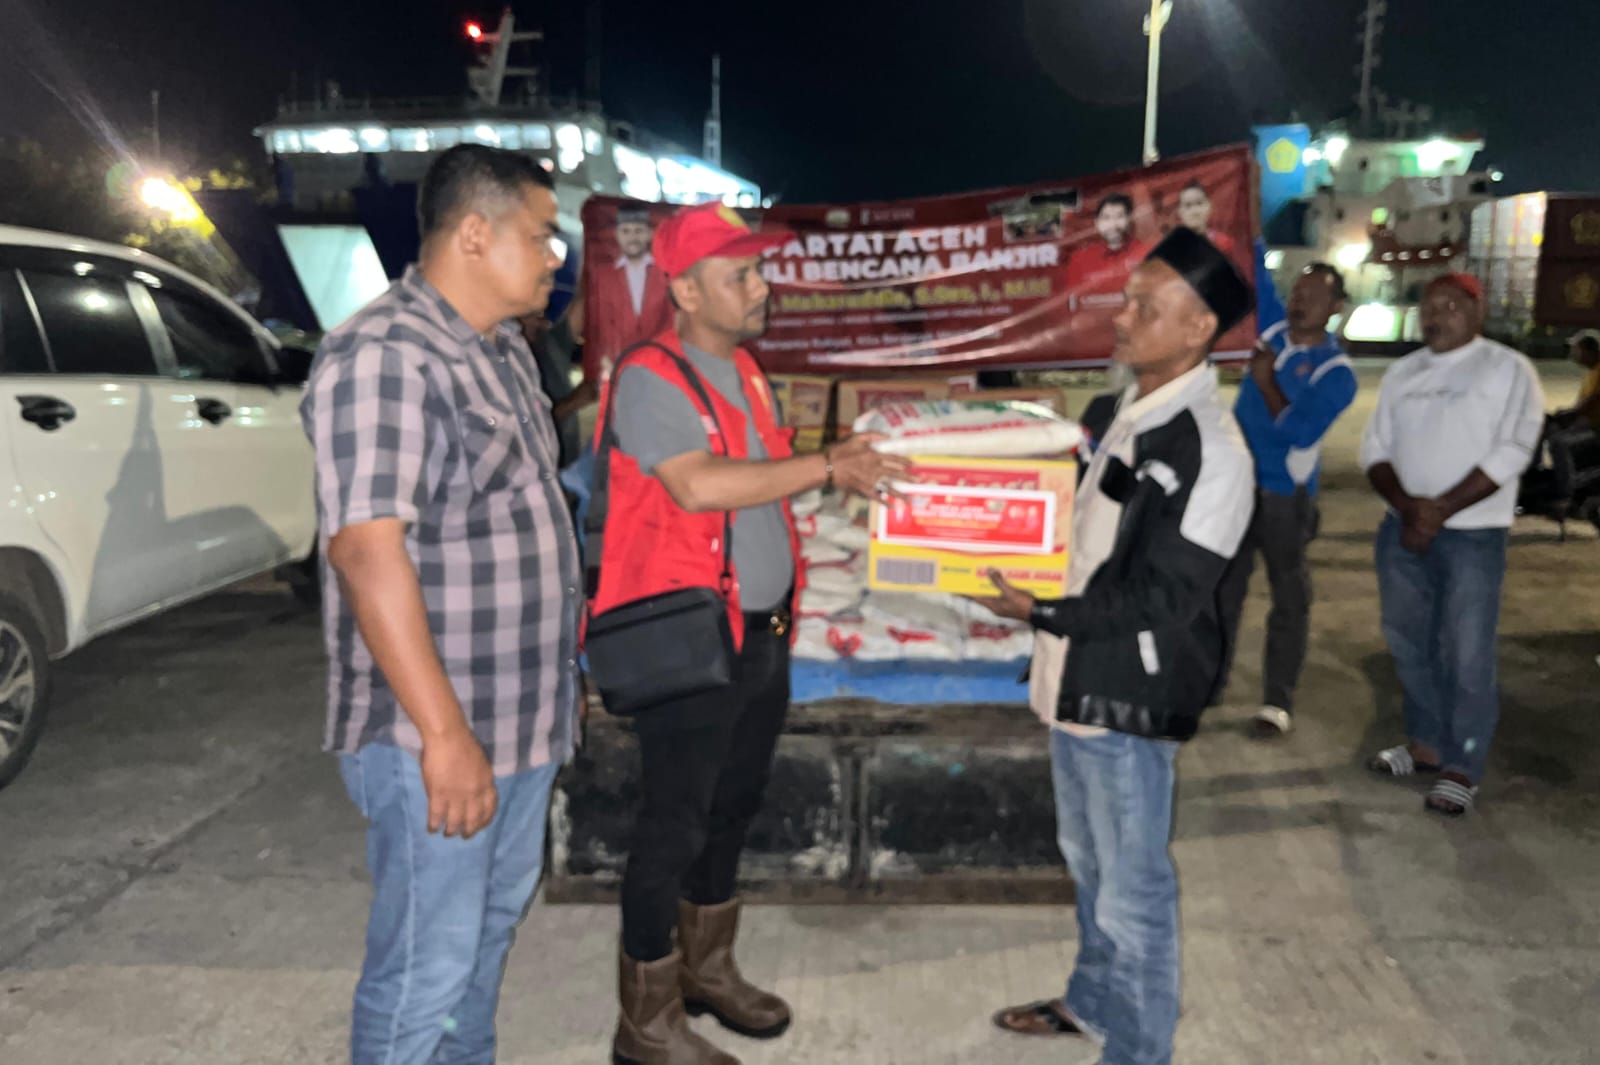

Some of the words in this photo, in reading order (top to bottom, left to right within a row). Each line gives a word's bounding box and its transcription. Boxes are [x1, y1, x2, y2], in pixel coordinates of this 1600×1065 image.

[893, 225, 986, 254] ACEH
[803, 254, 942, 282] BENCANA
[949, 243, 1058, 272] BANJIR
